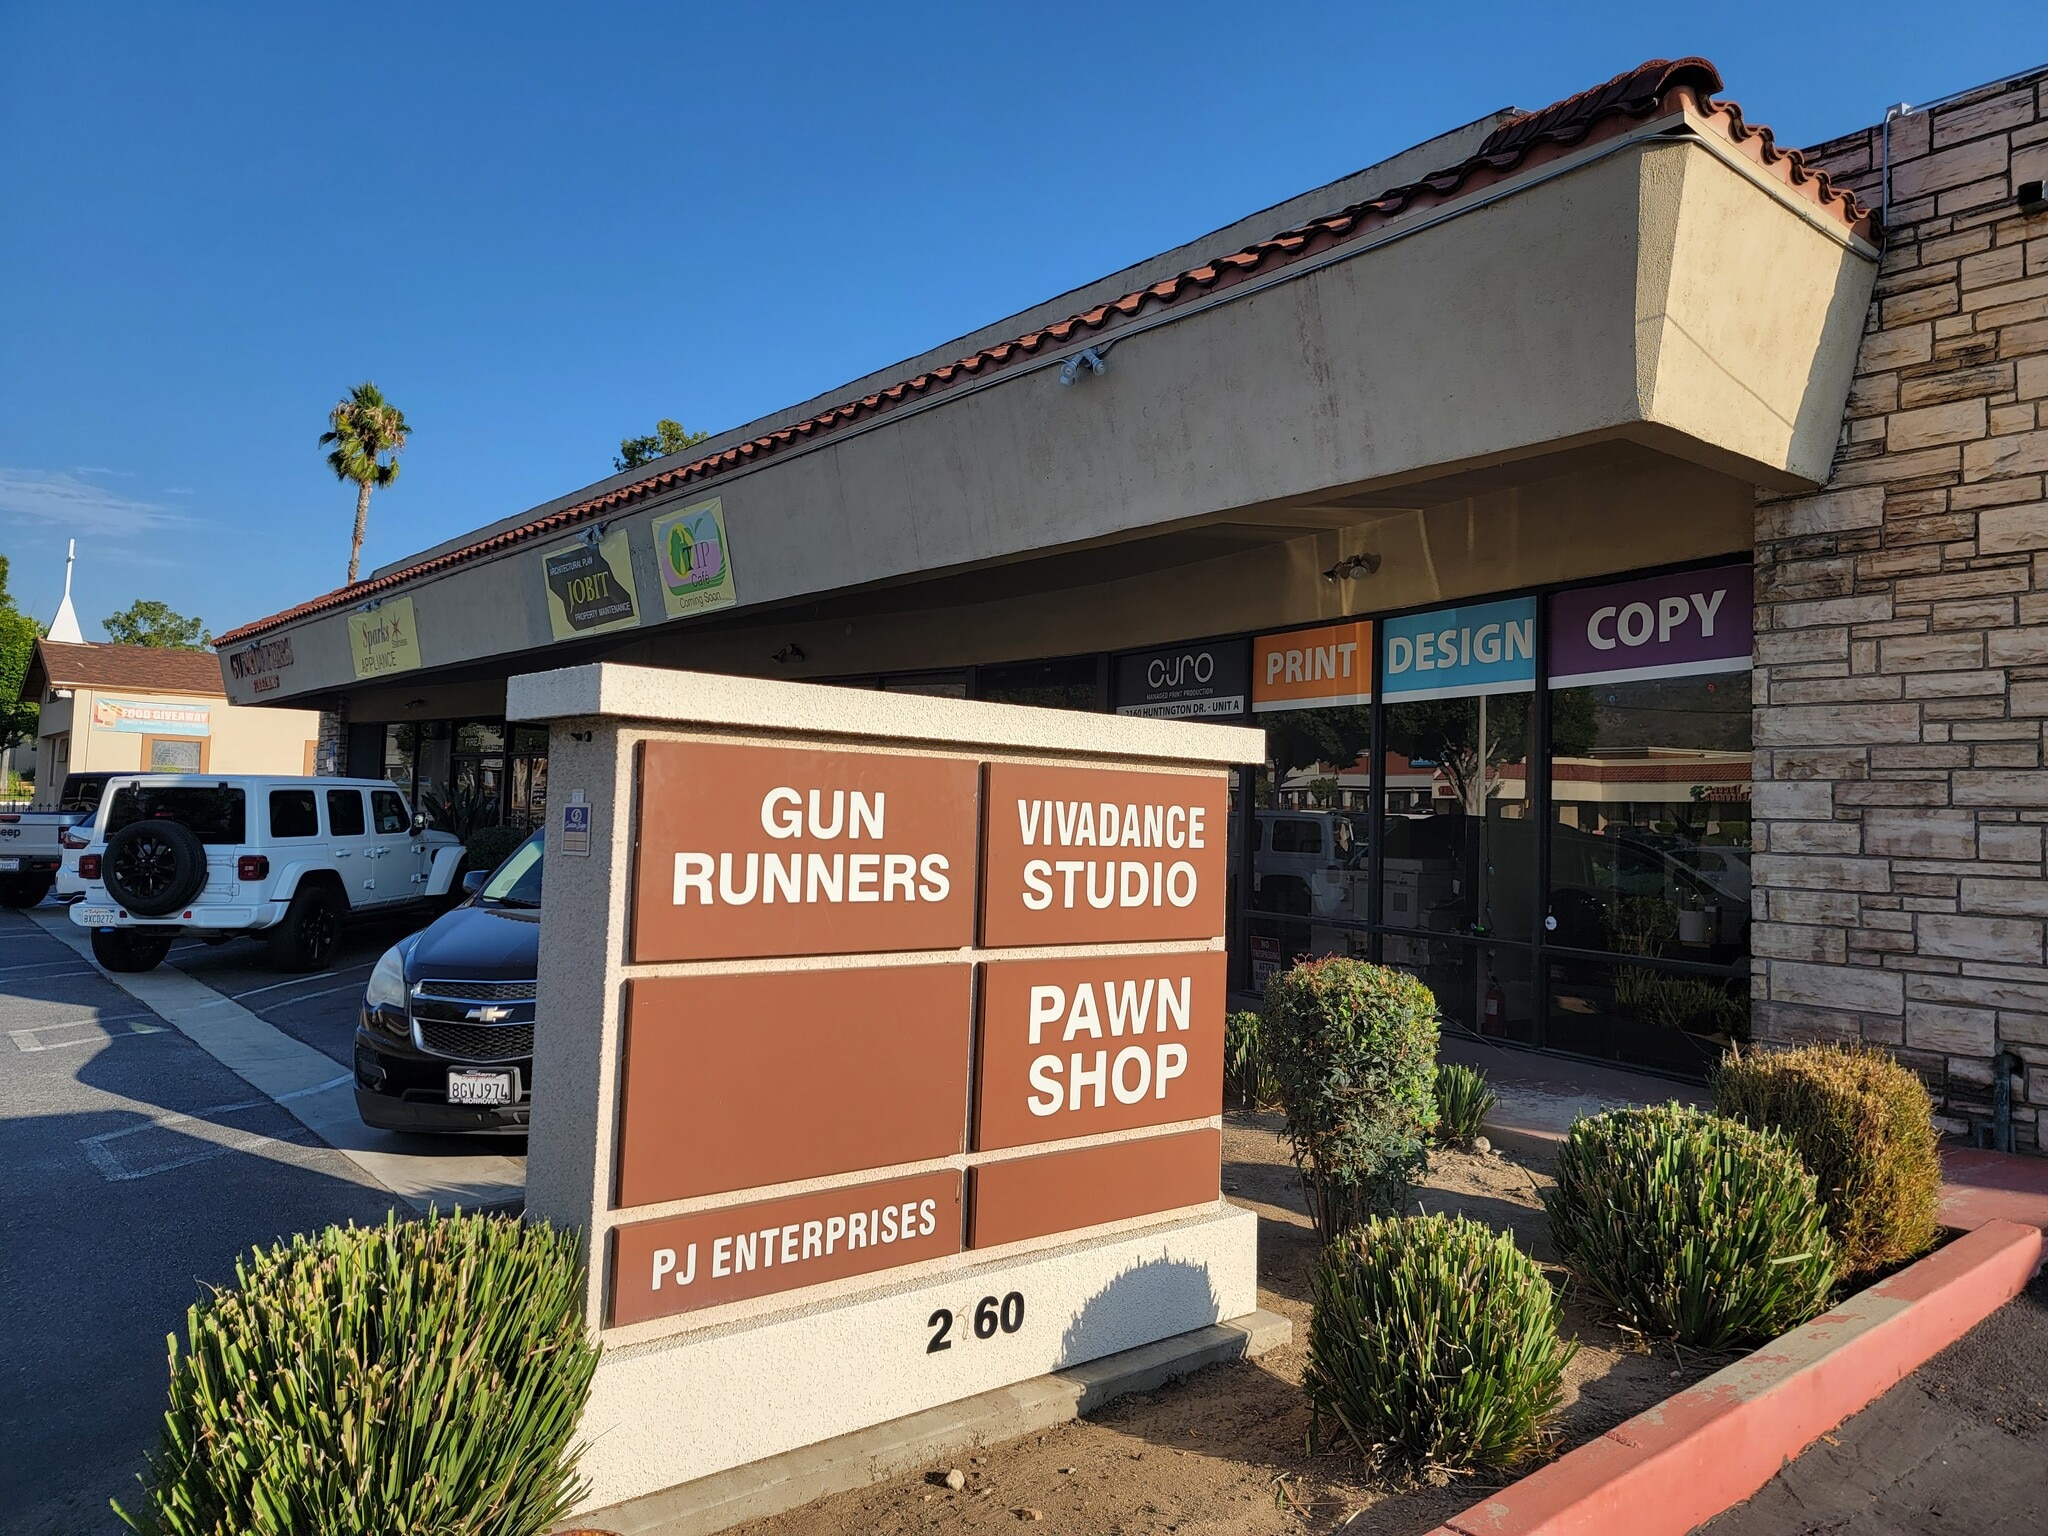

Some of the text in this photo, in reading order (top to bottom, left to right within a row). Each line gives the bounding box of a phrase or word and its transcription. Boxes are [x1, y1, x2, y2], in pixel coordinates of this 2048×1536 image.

[682, 541, 710, 571] TIP
[567, 571, 609, 614] JOBIT
[691, 570, 711, 587] Café
[574, 601, 631, 622] PROPERTY MAINTENANCE
[680, 591, 722, 608] Coming Soon
[1586, 589, 1727, 650] COPY
[362, 617, 390, 654] Sparks
[1387, 618, 1535, 675] DESIGN
[361, 650, 398, 672] APPLIANCE
[1266, 642, 1358, 685] PRINT
[1143, 704, 1192, 717] HUNTINGTON
[1193, 703, 1206, 713] DR.
[1212, 701, 1232, 711] UNIT
[1233, 700, 1239, 710] A
[1146, 687, 1214, 700] MANAGED PRINT PRODUCTION
[122, 708, 207, 722] FOOD GIVEAWAY
[0, 829, 21, 838] eep
[761, 786, 886, 841] GUN
[1017, 799, 1206, 849] VIVADANCE
[672, 852, 950, 906] RUNNERS
[1022, 859, 1198, 911] STUDIO
[1028, 976, 1191, 1045] PAWN
[452, 1082, 509, 1099] 8GVJ974
[1027, 1043, 1188, 1117] SHOP
[651, 1198, 936, 1291] PJ ENTERPRISES
